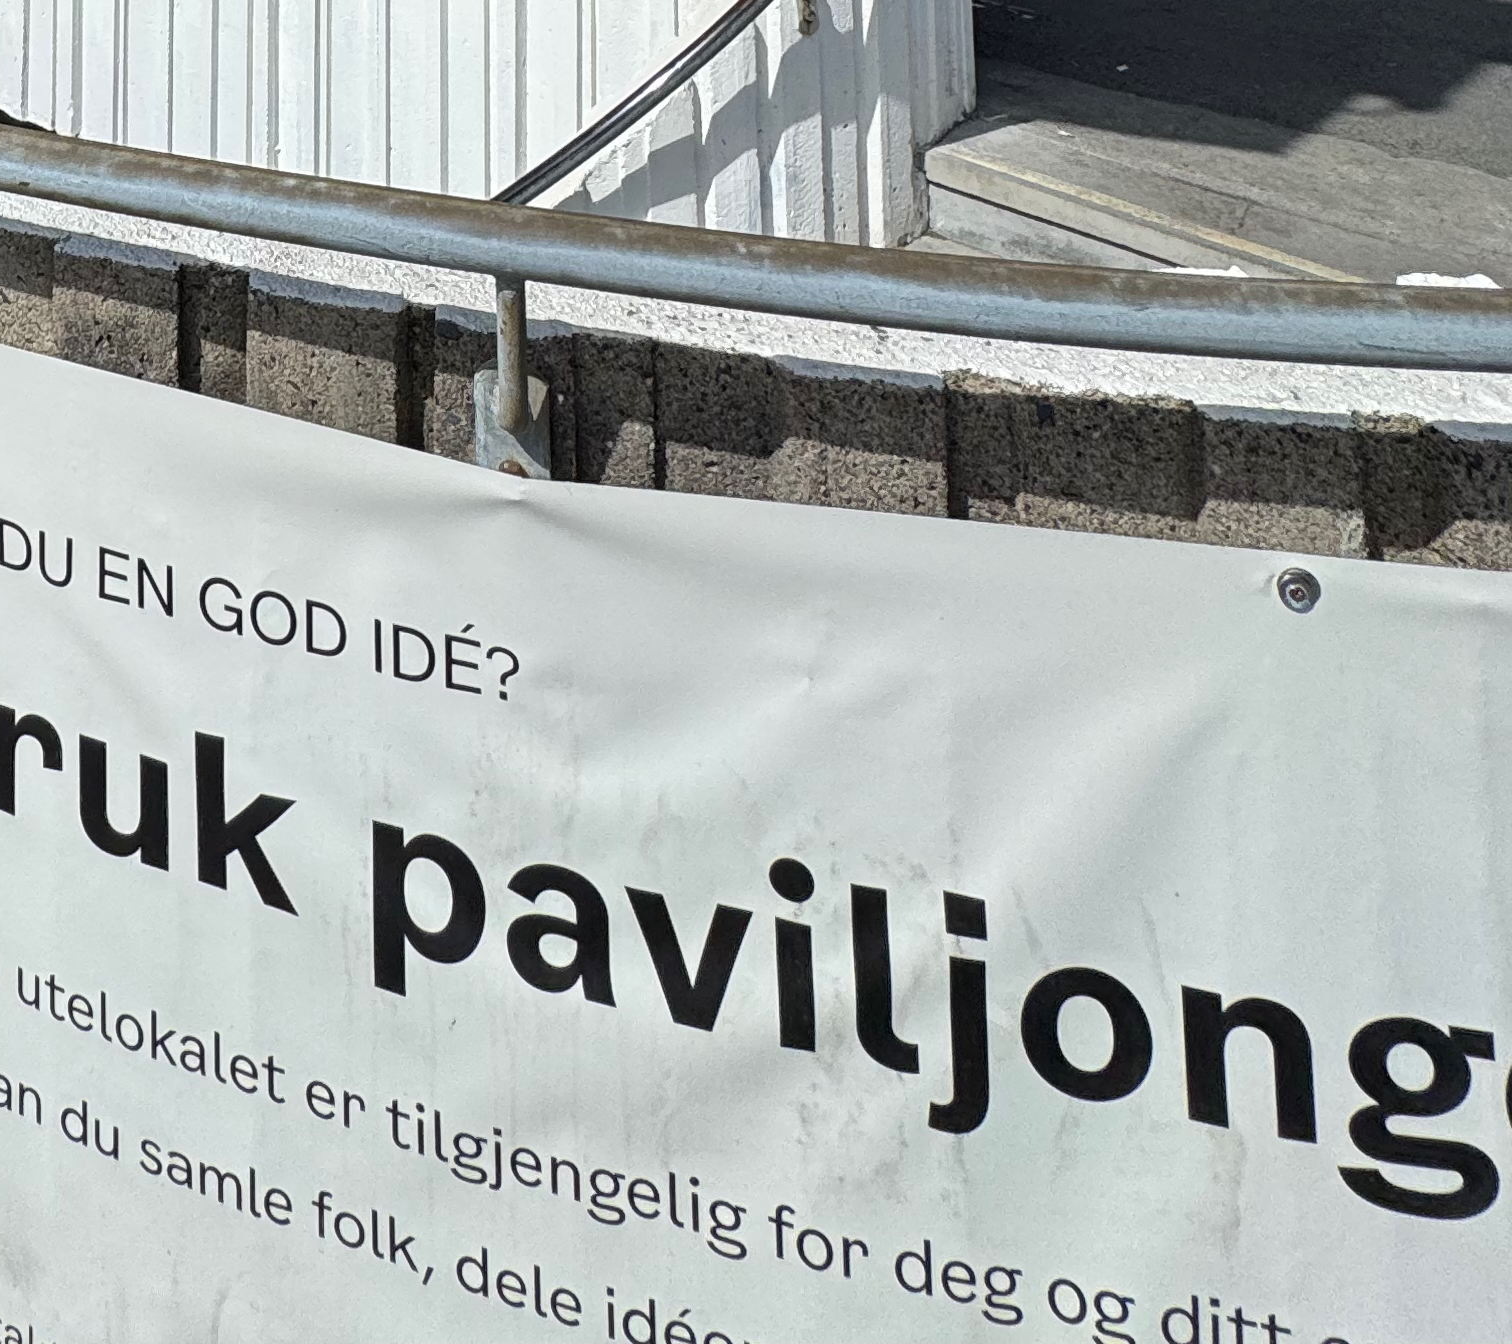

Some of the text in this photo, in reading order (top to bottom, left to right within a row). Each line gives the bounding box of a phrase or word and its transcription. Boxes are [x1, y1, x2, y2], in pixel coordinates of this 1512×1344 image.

[98, 546, 174, 617] EN
[199, 577, 347, 657] GOD
[374, 618, 520, 702] IDÉ?
[17, 967, 286, 1104] utelokalet
[305, 1080, 366, 1129] er
[385, 1100, 747, 1260] tilgjengelig
[768, 1204, 869, 1278] for
[894, 1239, 1024, 1326] deg
[1047, 1279, 1136, 1344] og
[372, 820, 1512, 1220] paviljong
[60, 1100, 119, 1160] du
[140, 1139, 293, 1226] samle
[311, 1191, 434, 1286] folk,
[456, 1247, 582, 1327] dele
